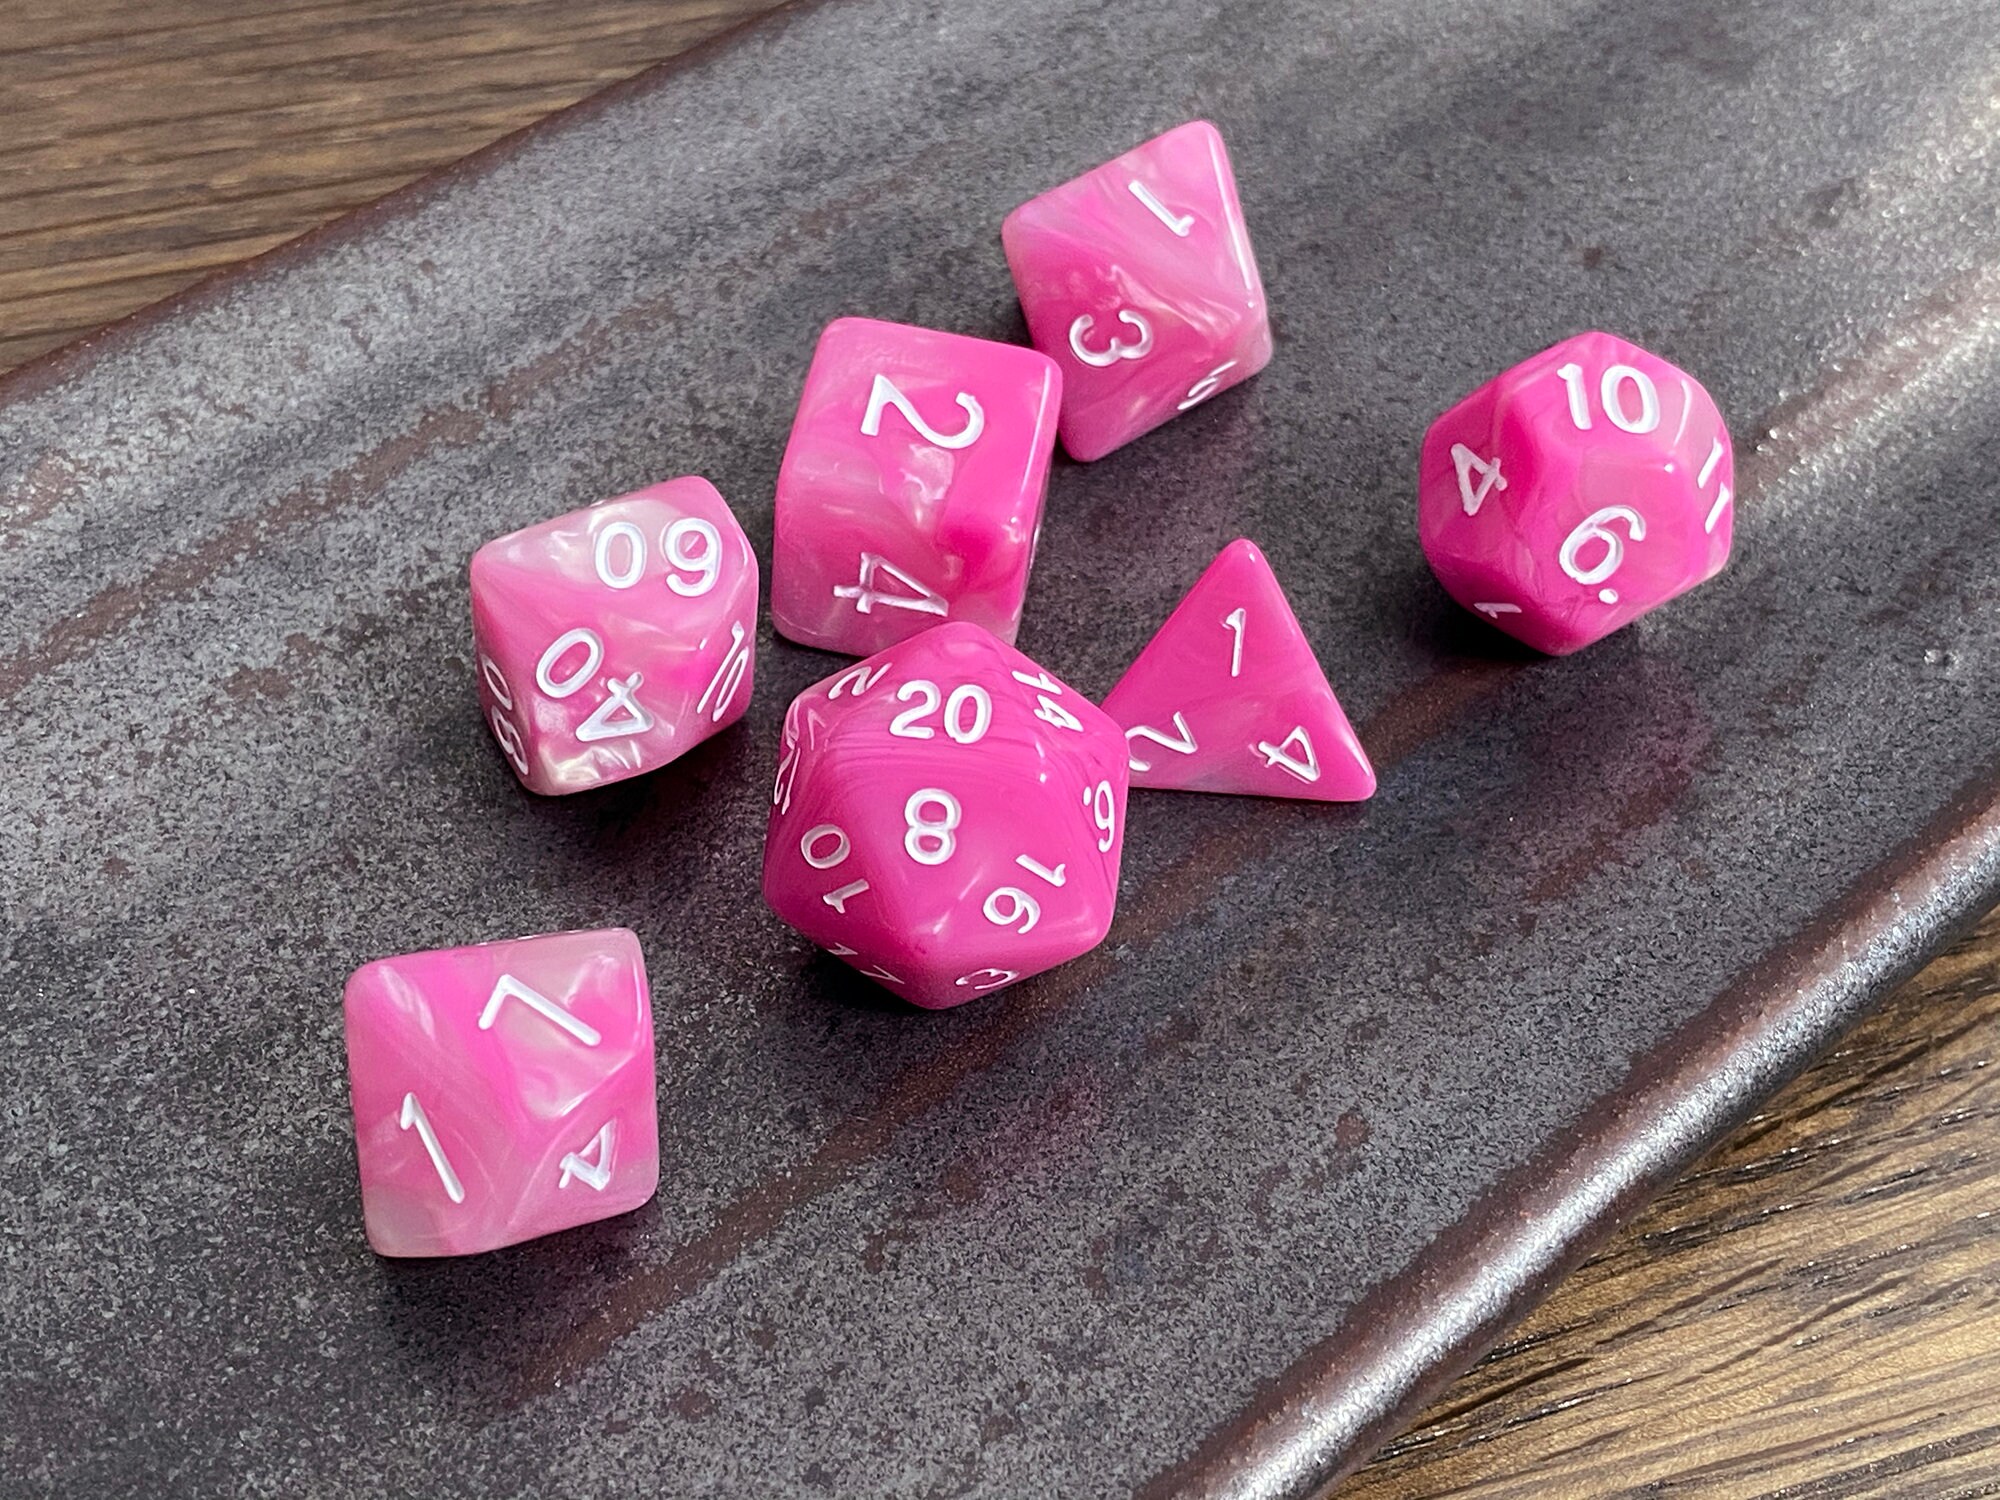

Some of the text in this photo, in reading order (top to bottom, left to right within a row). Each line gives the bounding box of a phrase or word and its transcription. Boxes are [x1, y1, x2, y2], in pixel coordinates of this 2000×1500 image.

[1128, 179, 1195, 238] 1
[1069, 309, 1152, 367] 3
[860, 373, 985, 450] 2
[1557, 362, 1661, 435] 10
[1450, 443, 1508, 517] 4
[833, 551, 949, 618] 4
[1220, 607, 1247, 678] 1
[828, 662, 893, 700] 2
[889, 679, 993, 744] 20
[1011, 670, 1084, 732] 14
[1124, 711, 1199, 772] 2
[1253, 725, 1321, 784] 4
[903, 787, 962, 866] 8
[800, 823, 870, 915] 10
[982, 853, 1067, 935] 16
[478, 974, 602, 1047] 7
[400, 1092, 465, 1204] 1
[558, 1117, 619, 1192] 4
